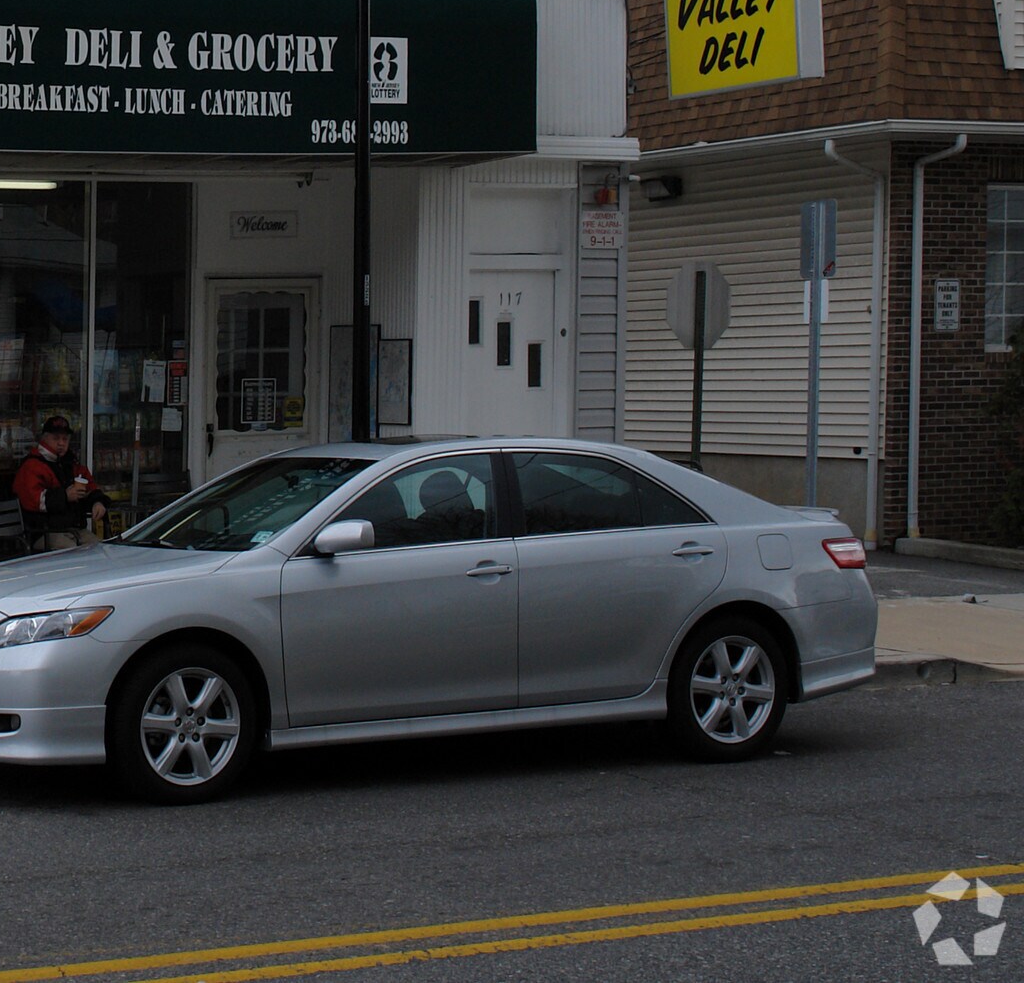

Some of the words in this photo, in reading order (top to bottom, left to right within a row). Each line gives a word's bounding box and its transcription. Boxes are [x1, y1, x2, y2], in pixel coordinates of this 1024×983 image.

[64, 27, 143, 69] DELI
[152, 30, 177, 69] &
[187, 31, 338, 74] GROCERY
[699, 26, 765, 75] DELI
[124, 87, 186, 115] LUNCH
[200, 89, 293, 117] CATERING
[371, 88, 400, 98] LOTTERY
[311, 119, 409, 144] 973-68-2993
[237, 215, 288, 233] Welcome
[590, 235, 615, 246] 9-1-1
[499, 291, 522, 306] 117
